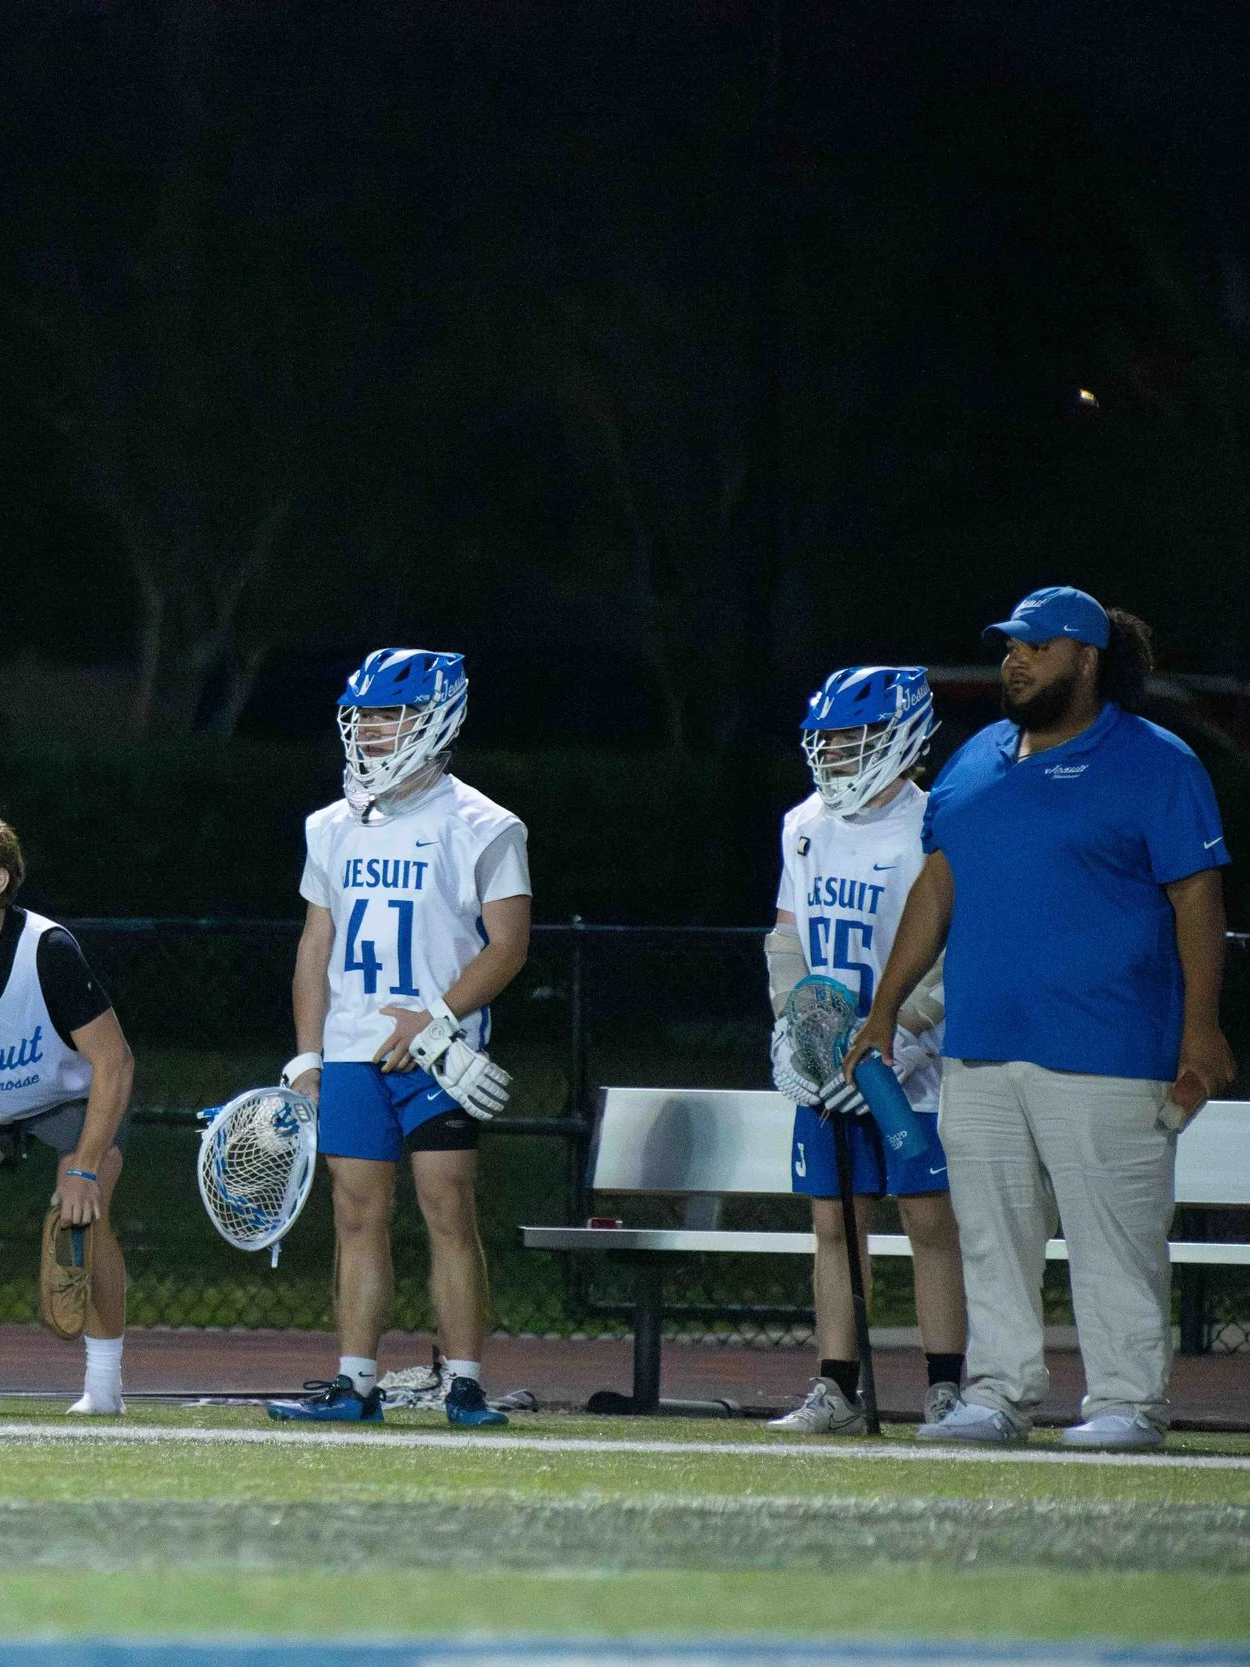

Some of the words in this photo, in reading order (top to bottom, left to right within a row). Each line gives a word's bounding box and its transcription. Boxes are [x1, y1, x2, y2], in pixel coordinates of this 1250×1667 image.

[343, 858, 429, 890] JESUIT
[807, 876, 885, 915] JESUIT
[344, 898, 420, 997] 41
[795, 1142, 807, 1177] J
